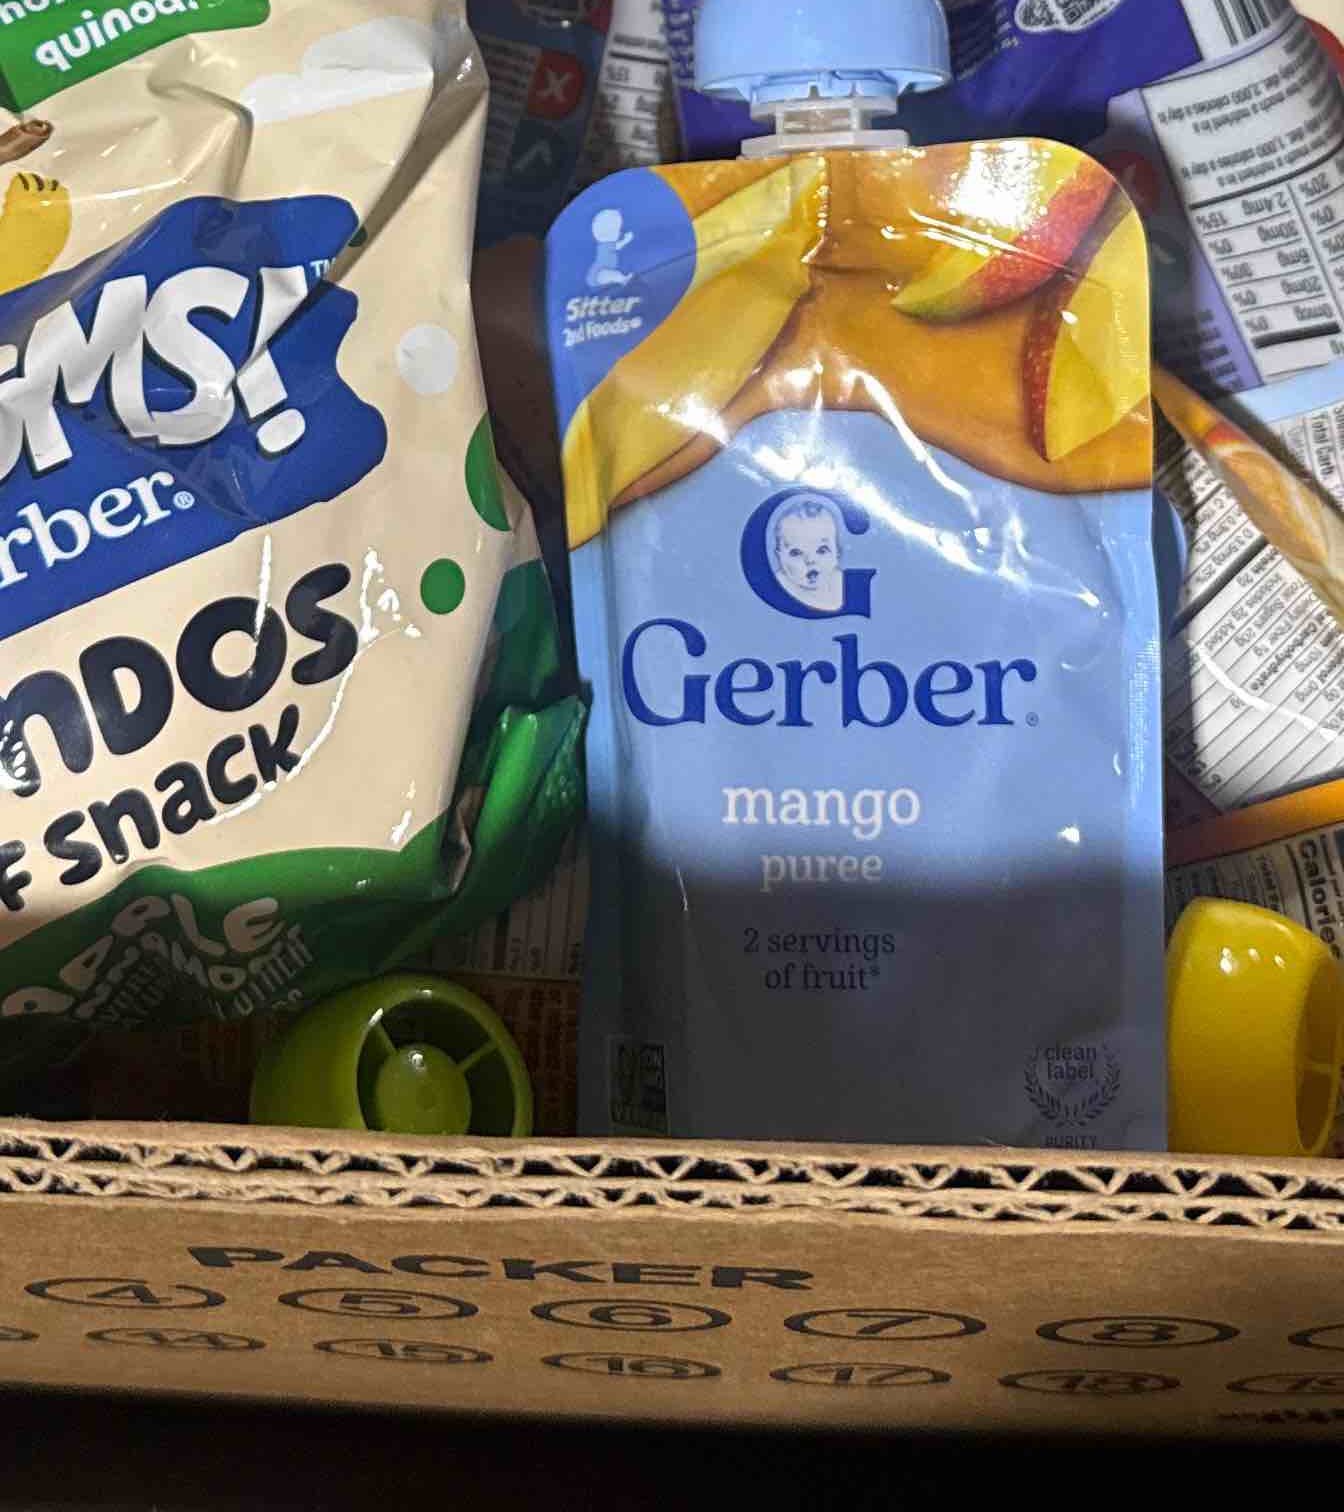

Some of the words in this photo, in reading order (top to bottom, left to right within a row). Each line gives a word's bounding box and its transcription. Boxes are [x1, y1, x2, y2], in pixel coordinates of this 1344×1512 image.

[722, 782, 921, 832] mango
[760, 849, 884, 893] puree
[1299, 839, 1343, 961] Calories
[742, 927, 760, 953] 2
[766, 928, 896, 960] servings
[764, 962, 797, 990] of
[187, 1244, 815, 1290] PACKER
